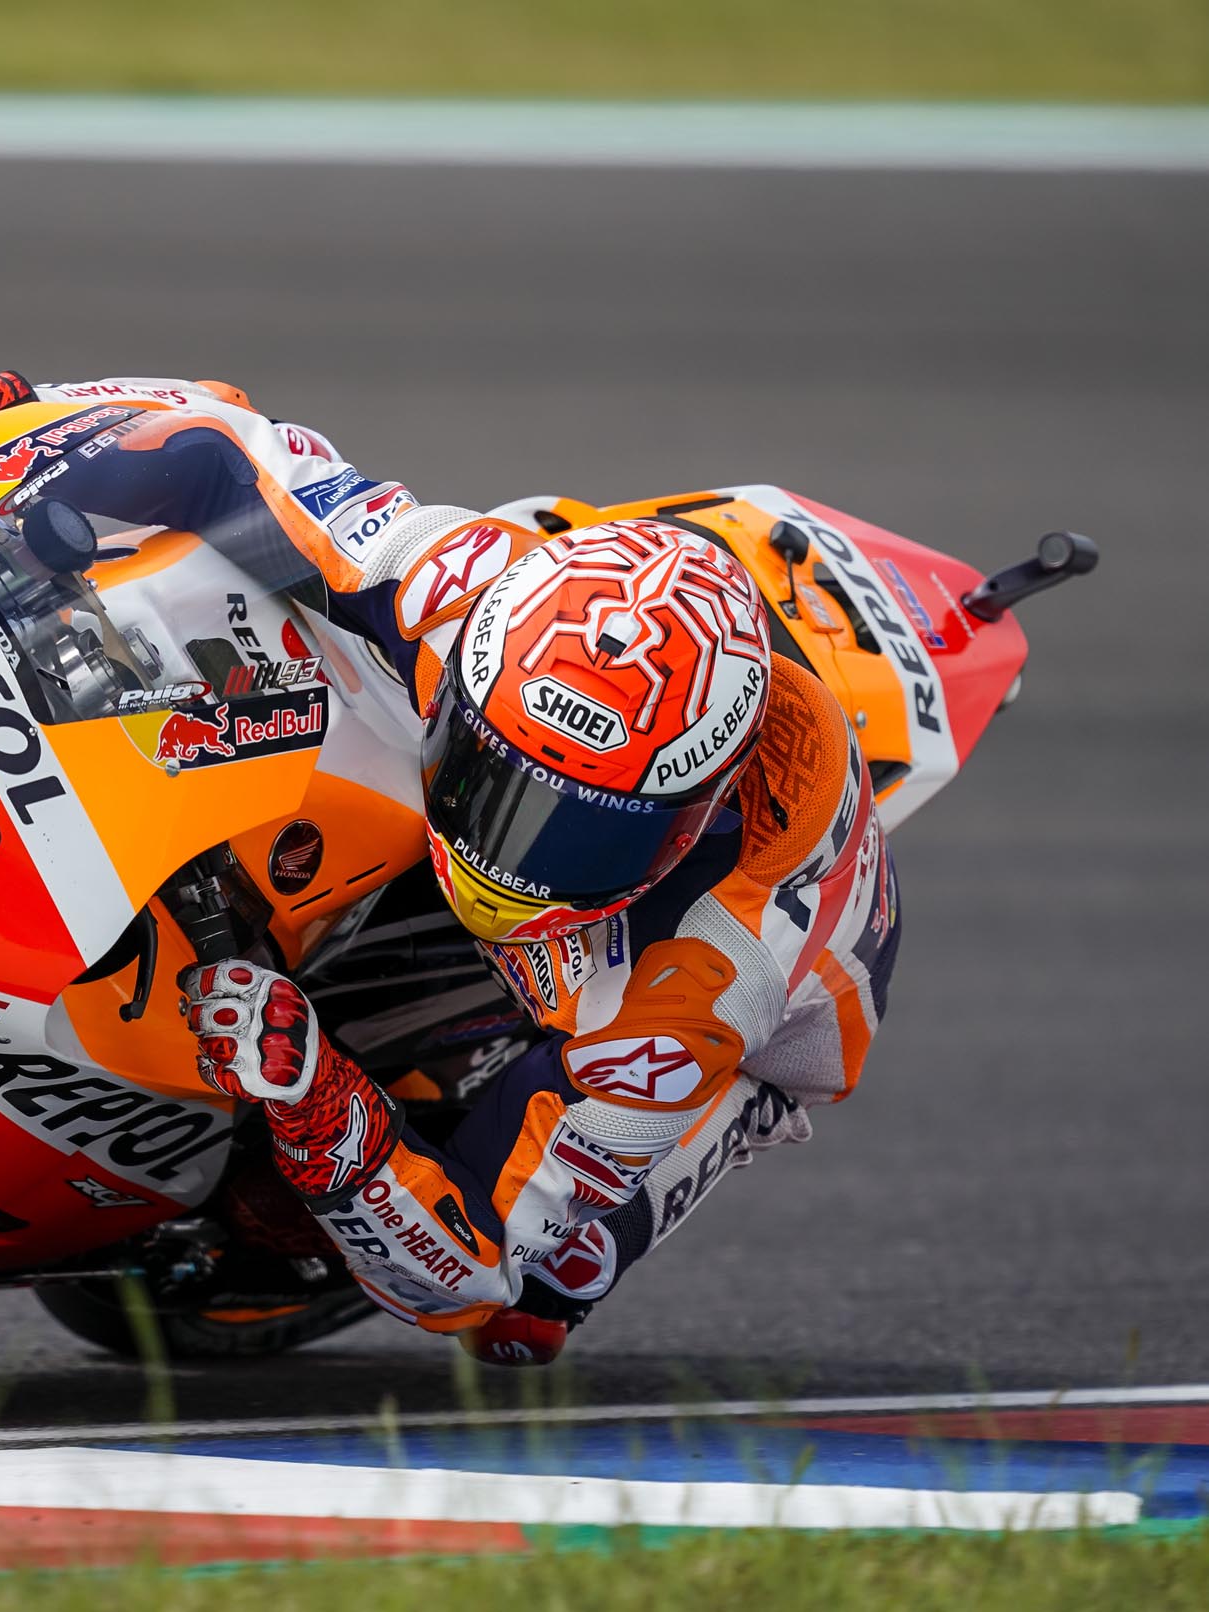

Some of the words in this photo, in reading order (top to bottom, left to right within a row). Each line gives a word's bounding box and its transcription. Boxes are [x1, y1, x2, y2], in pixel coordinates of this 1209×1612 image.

[78, 433, 118, 460] 93
[472, 552, 539, 688] PULL&BEAR
[118, 684, 193, 705] Puig
[532, 685, 617, 744] SHOEI
[657, 666, 760, 787] PULL&BEAR
[464, 708, 509, 759] GIVES
[520, 757, 565, 791] YOU
[577, 785, 655, 813] WINGS
[274, 869, 311, 880] HONDA
[453, 837, 551, 900] PULL&BEAR
[362, 1180, 405, 1229] One
[395, 1222, 474, 1293] HEART.
